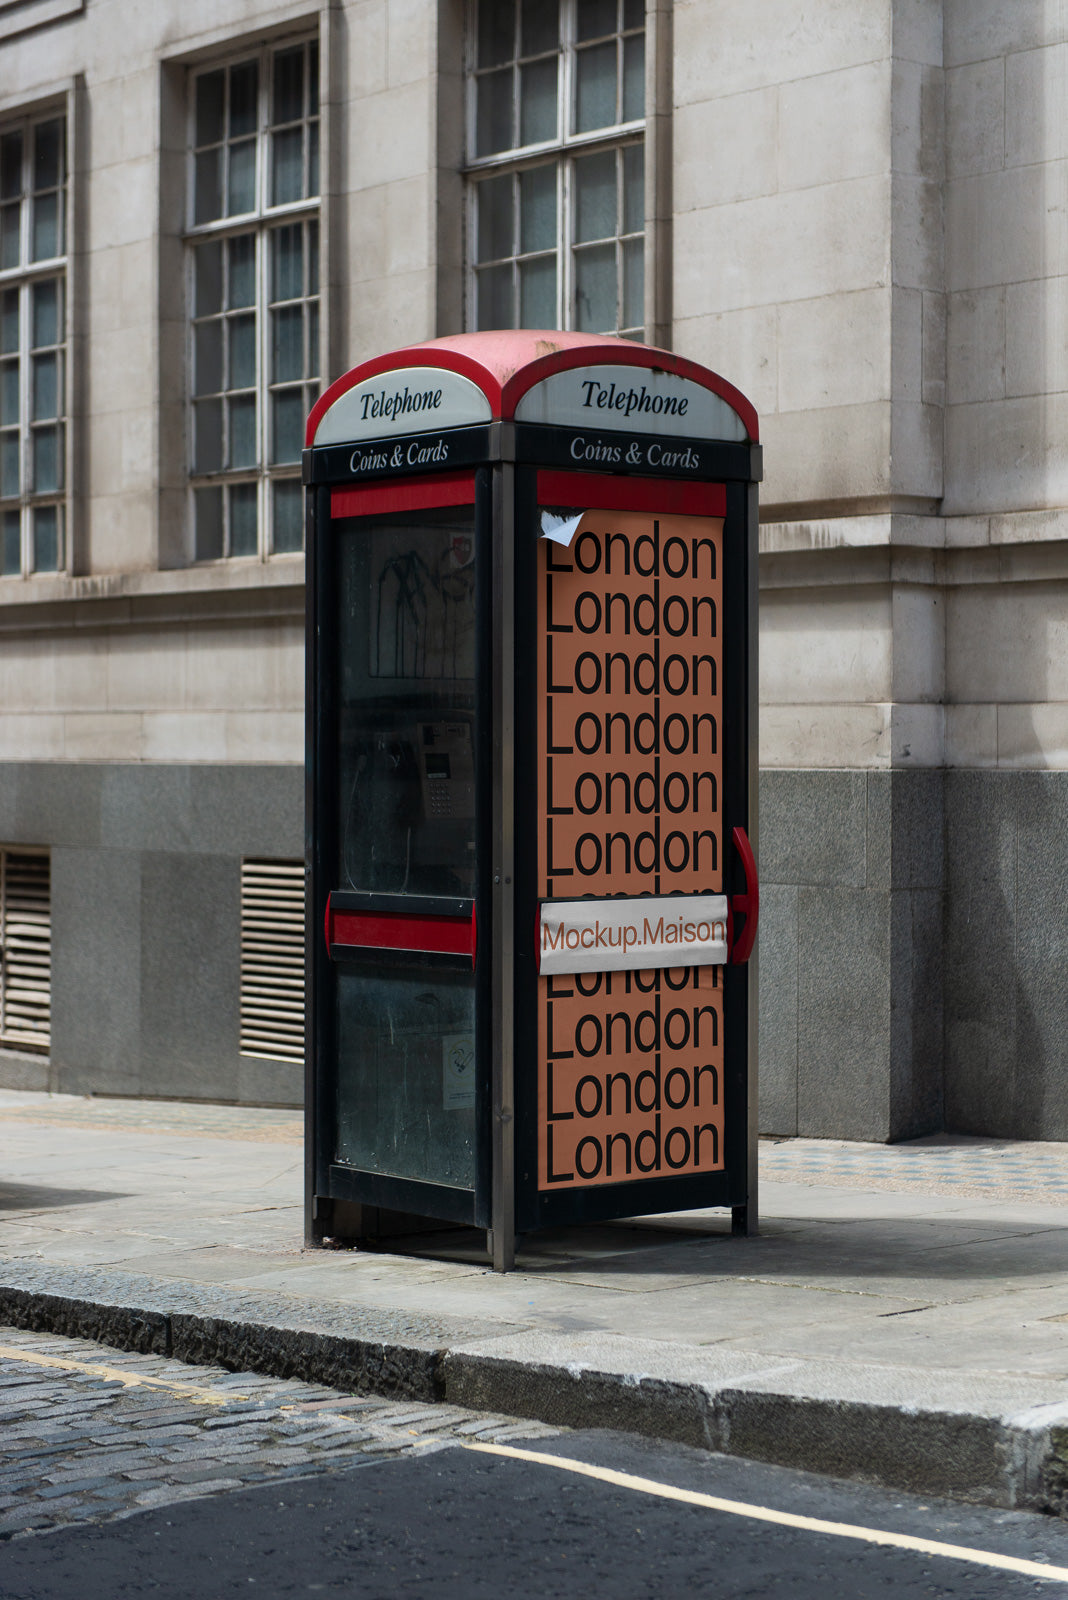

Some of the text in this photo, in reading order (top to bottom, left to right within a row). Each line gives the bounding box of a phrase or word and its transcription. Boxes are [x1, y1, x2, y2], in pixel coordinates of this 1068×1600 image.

[360, 386, 442, 421] Telephone
[581, 380, 689, 417] Telephone
[349, 439, 449, 473] Coins & Cards
[570, 436, 700, 470] Coins & Cards
[546, 519, 717, 580] London
[546, 574, 718, 638] London
[546, 634, 718, 696] London
[546, 695, 718, 755] London
[546, 756, 718, 816] London
[546, 815, 718, 877] London
[542, 916, 726, 953] Mockup.Maison
[546, 994, 719, 1060] London
[546, 1053, 719, 1122] London
[546, 1113, 719, 1184] London
